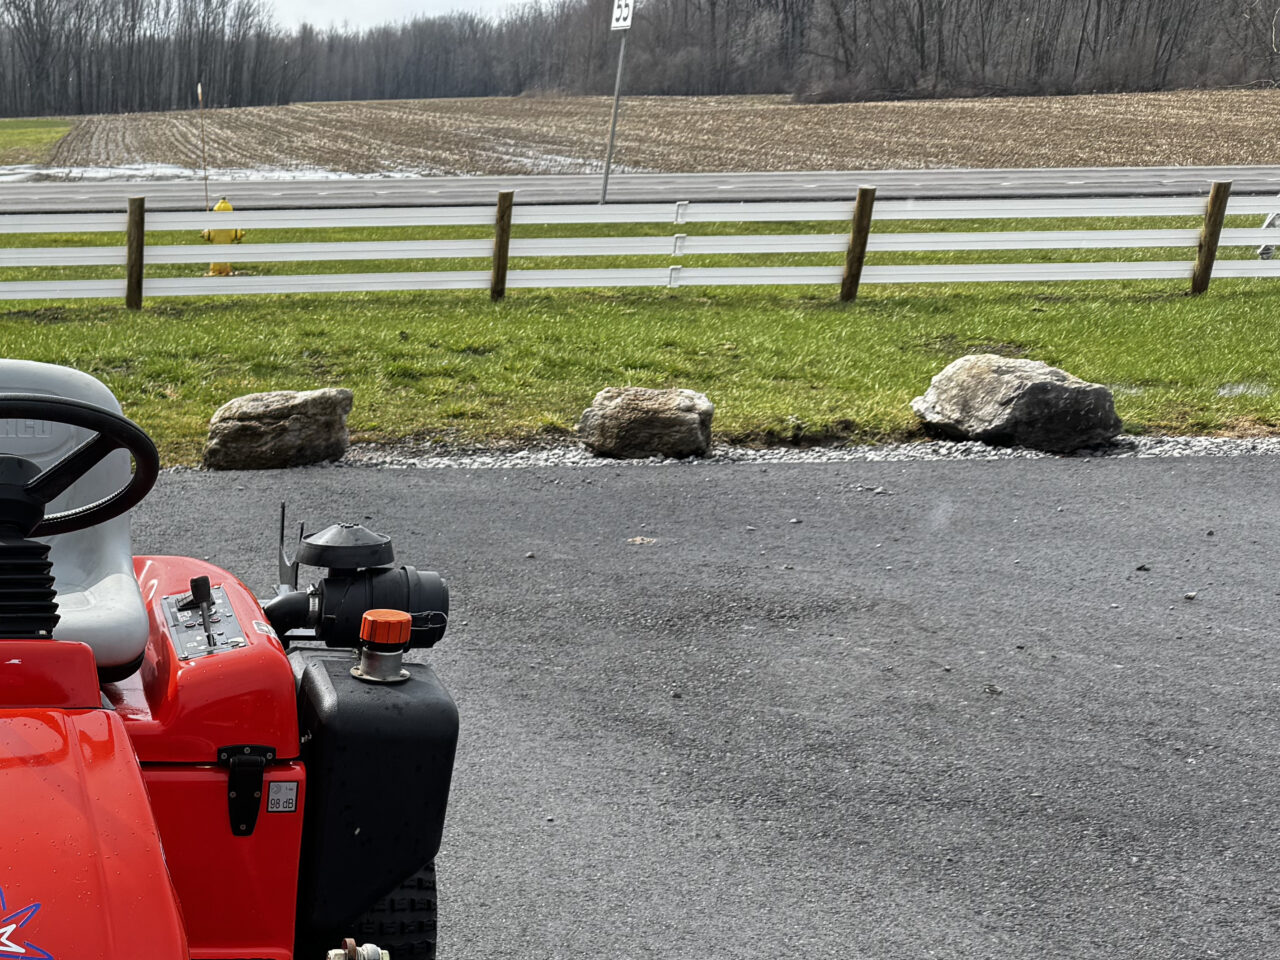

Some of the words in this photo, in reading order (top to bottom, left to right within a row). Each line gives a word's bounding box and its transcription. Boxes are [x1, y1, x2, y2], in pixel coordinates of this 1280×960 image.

[615, 0, 630, 22] 55
[270, 798, 281, 809] 98
[282, 798, 294, 809] dB
